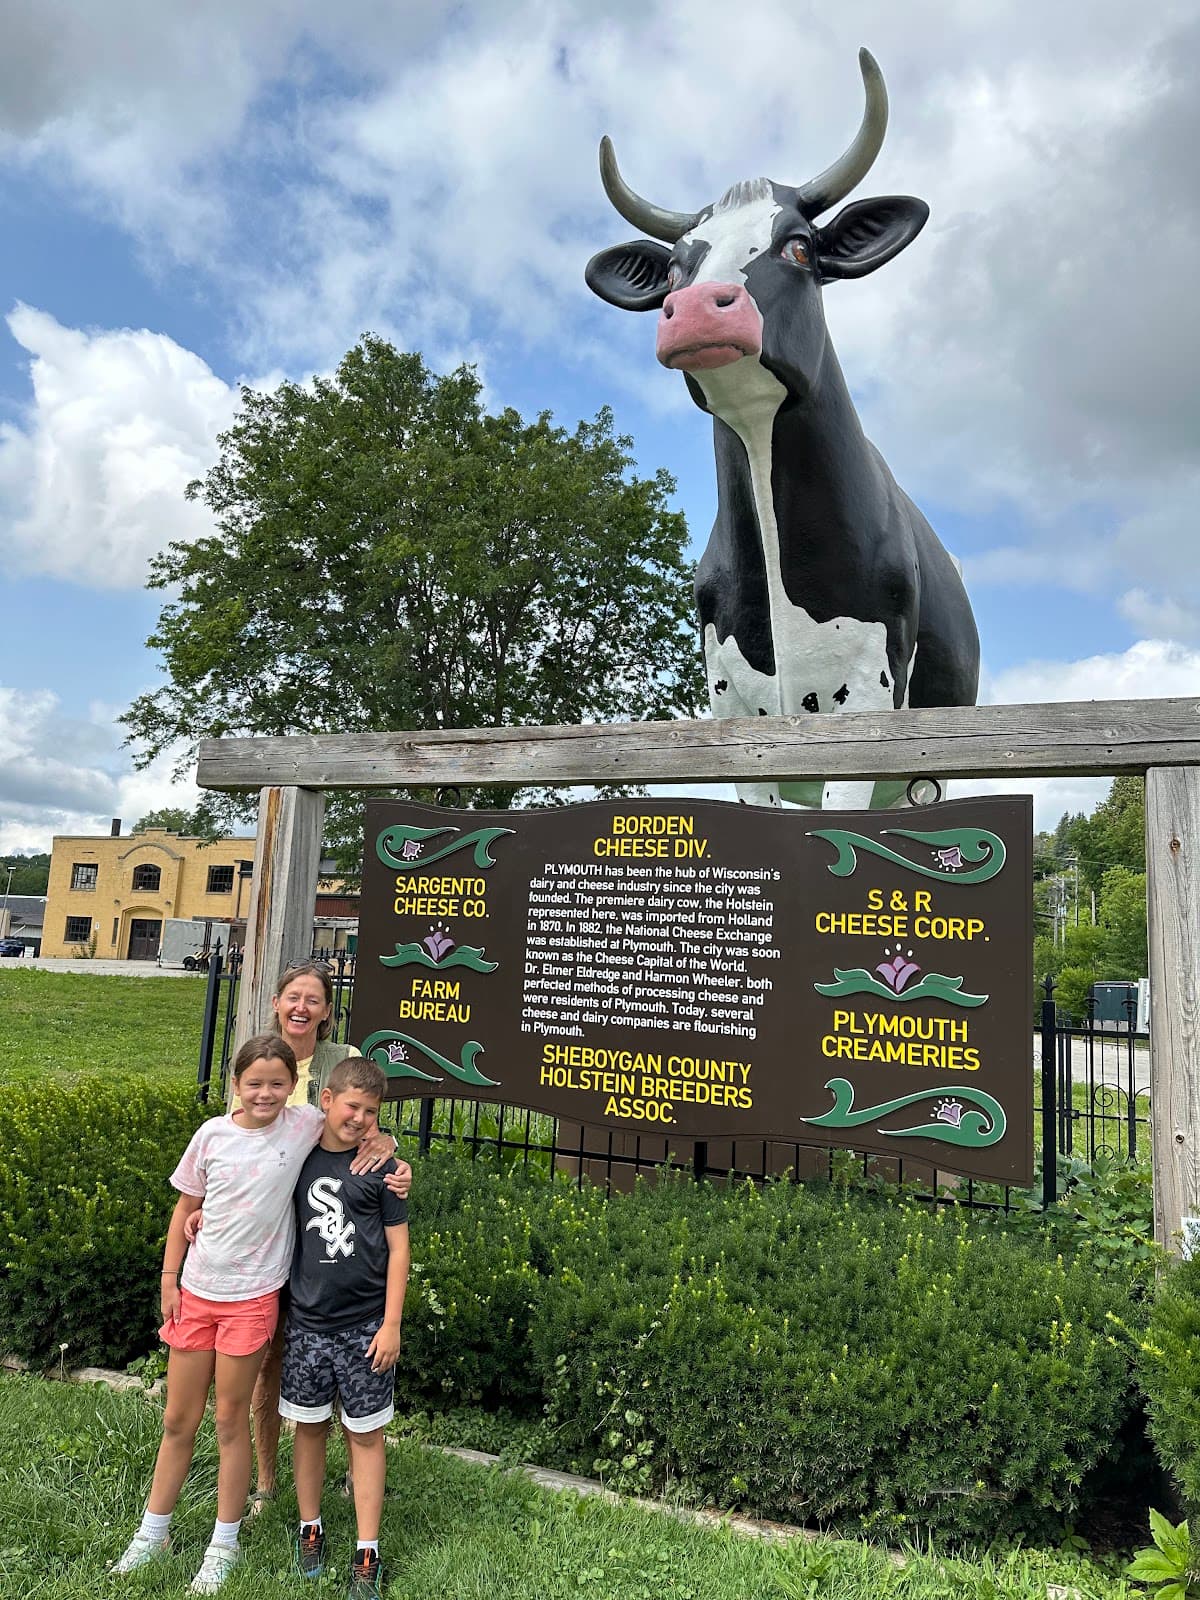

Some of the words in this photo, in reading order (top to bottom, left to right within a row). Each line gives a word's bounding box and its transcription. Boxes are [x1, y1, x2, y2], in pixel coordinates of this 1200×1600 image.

[613, 816, 693, 835] BORDEN
[594, 838, 669, 857] CHEESE
[675, 839, 711, 858] DIV.
[545, 864, 602, 875] PLYMOUTH
[605, 865, 623, 876] has
[627, 865, 652, 877] been
[655, 866, 672, 877] the
[675, 866, 696, 878] hub
[699, 867, 710, 878] of
[395, 876, 487, 897] SARGENTO
[530, 877, 555, 891] dairy
[557, 879, 576, 889] and
[578, 879, 614, 890] cheese
[617, 880, 661, 894] industry
[663, 881, 692, 893] since
[695, 882, 712, 893] the
[715, 882, 734, 897] city
[737, 886, 760, 895] was
[395, 897, 459, 916] CHEESE
[463, 900, 489, 917] CO.
[529, 891, 571, 903] founded.
[574, 893, 593, 904] The
[596, 894, 645, 907] premiere
[646, 895, 674, 912] dairy
[705, 897, 723, 909] the
[726, 898, 773, 911] Holstein
[868, 889, 883, 910] S
[890, 890, 908, 911] &
[915, 891, 931, 912] R
[528, 908, 589, 919] represented
[621, 912, 643, 921] was
[645, 909, 696, 925] imported
[698, 912, 725, 924] from
[728, 913, 772, 926] Holland
[816, 913, 908, 937] CHEESE
[915, 917, 989, 941] CORP.
[528, 920, 536, 930] in
[540, 920, 563, 932] 1870.
[566, 921, 575, 932] In
[606, 923, 622, 934] the
[626, 924, 669, 937] National
[672, 926, 713, 939] Cheese
[716, 928, 772, 945] Exchange
[527, 936, 546, 945] was
[549, 936, 607, 948] established
[610, 939, 620, 949] at
[623, 939, 676, 953] Plymouth.
[680, 941, 700, 954] The
[703, 943, 723, 958] city
[725, 947, 749, 956] was
[752, 948, 780, 958] soon
[526, 948, 559, 960] known
[562, 953, 573, 961] as
[576, 951, 592, 962] the
[595, 952, 634, 965] Cheese
[637, 954, 673, 969] Capital
[676, 957, 687, 968] of
[689, 958, 707, 969] the
[710, 959, 747, 972] World.
[525, 962, 539, 974] Dr.
[543, 963, 574, 976] Elmer
[577, 966, 620, 982] Eldredge
[622, 969, 642, 980] and
[645, 970, 689, 984] Harmon
[747, 977, 772, 990] both
[411, 979, 461, 1001] FARM
[524, 978, 571, 990] perfected
[574, 981, 619, 994] methods
[622, 984, 633, 995] of
[635, 987, 695, 1002] processing
[698, 989, 738, 1003] cheese
[742, 993, 763, 1005] and
[400, 1000, 470, 1023] BUREAU
[523, 994, 548, 1004] were
[551, 995, 599, 1007] residents
[602, 998, 613, 1009] of
[615, 998, 669, 1013] Plymouth.
[711, 1008, 753, 1020] several
[521, 1021, 531, 1032] in
[534, 1021, 584, 1037] Plymouth.
[522, 1006, 558, 1019] cheese
[560, 1010, 579, 1021] and
[582, 1011, 608, 1026] dairy
[611, 1016, 669, 1029] companies
[673, 1021, 691, 1030] are
[694, 1020, 756, 1040] flourishing
[834, 1010, 967, 1042] PLYMOUTH
[541, 1044, 662, 1075] SHEBOYGAN
[668, 1056, 751, 1084] COUNTY
[822, 1036, 980, 1070] CREAMERIES
[539, 1066, 636, 1095] HOLSTEIN
[641, 1076, 753, 1109] BREEDERS
[604, 1096, 676, 1123] ASSOC.
